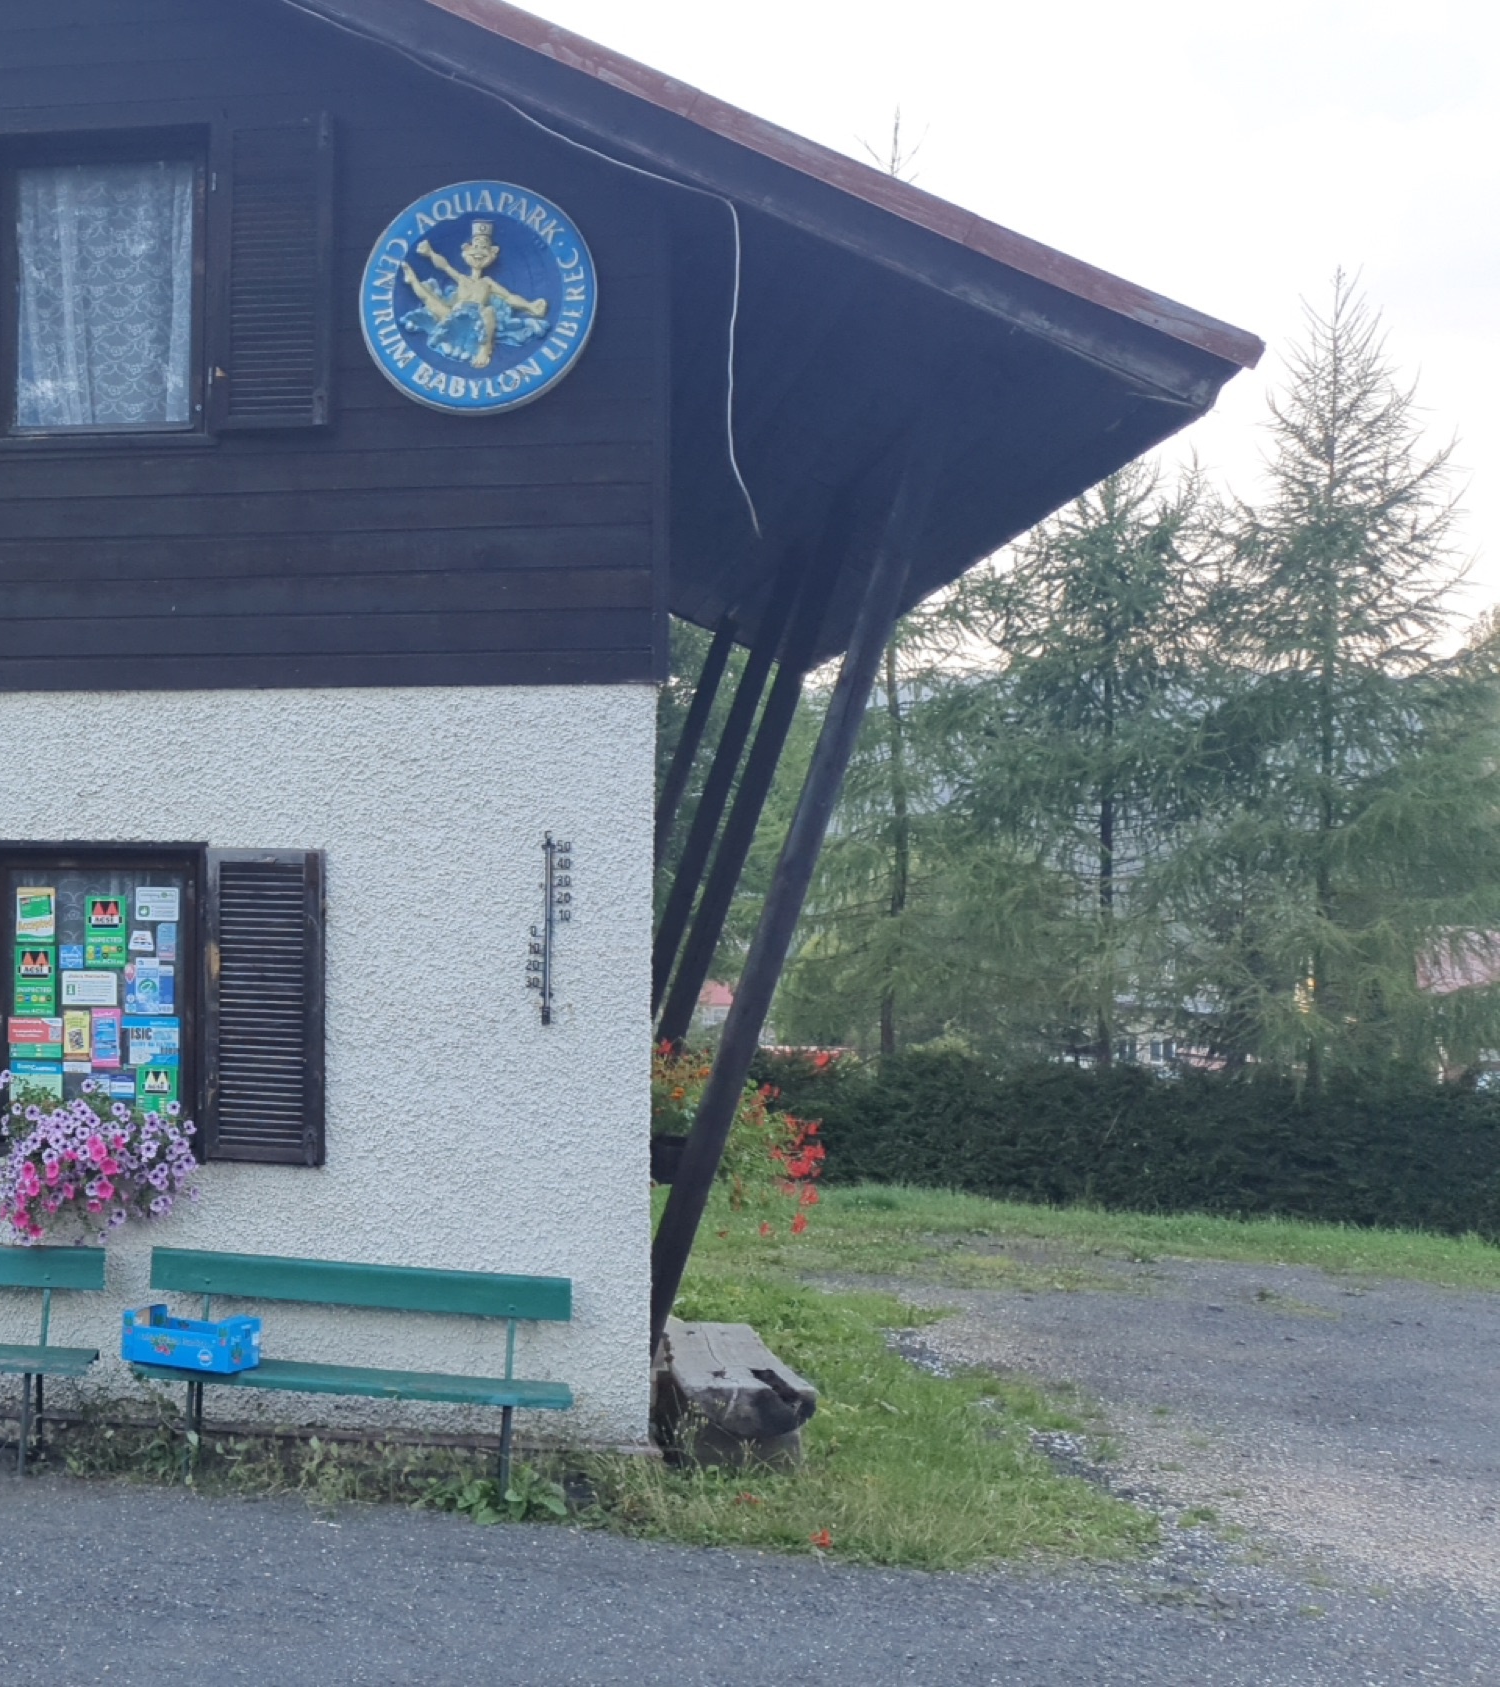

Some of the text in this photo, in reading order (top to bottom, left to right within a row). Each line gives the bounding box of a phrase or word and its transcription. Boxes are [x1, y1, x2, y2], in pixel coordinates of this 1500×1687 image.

[415, 189, 565, 245] AQUAPARK
[371, 237, 586, 399] CENTRUM BABYLON LIBEREC
[557, 840, 571, 851] 50
[557, 858, 571, 869] 40
[557, 892, 571, 904] 20
[559, 909, 571, 921] 10
[525, 960, 540, 971] 20
[130, 1027, 153, 1040] ISIC
